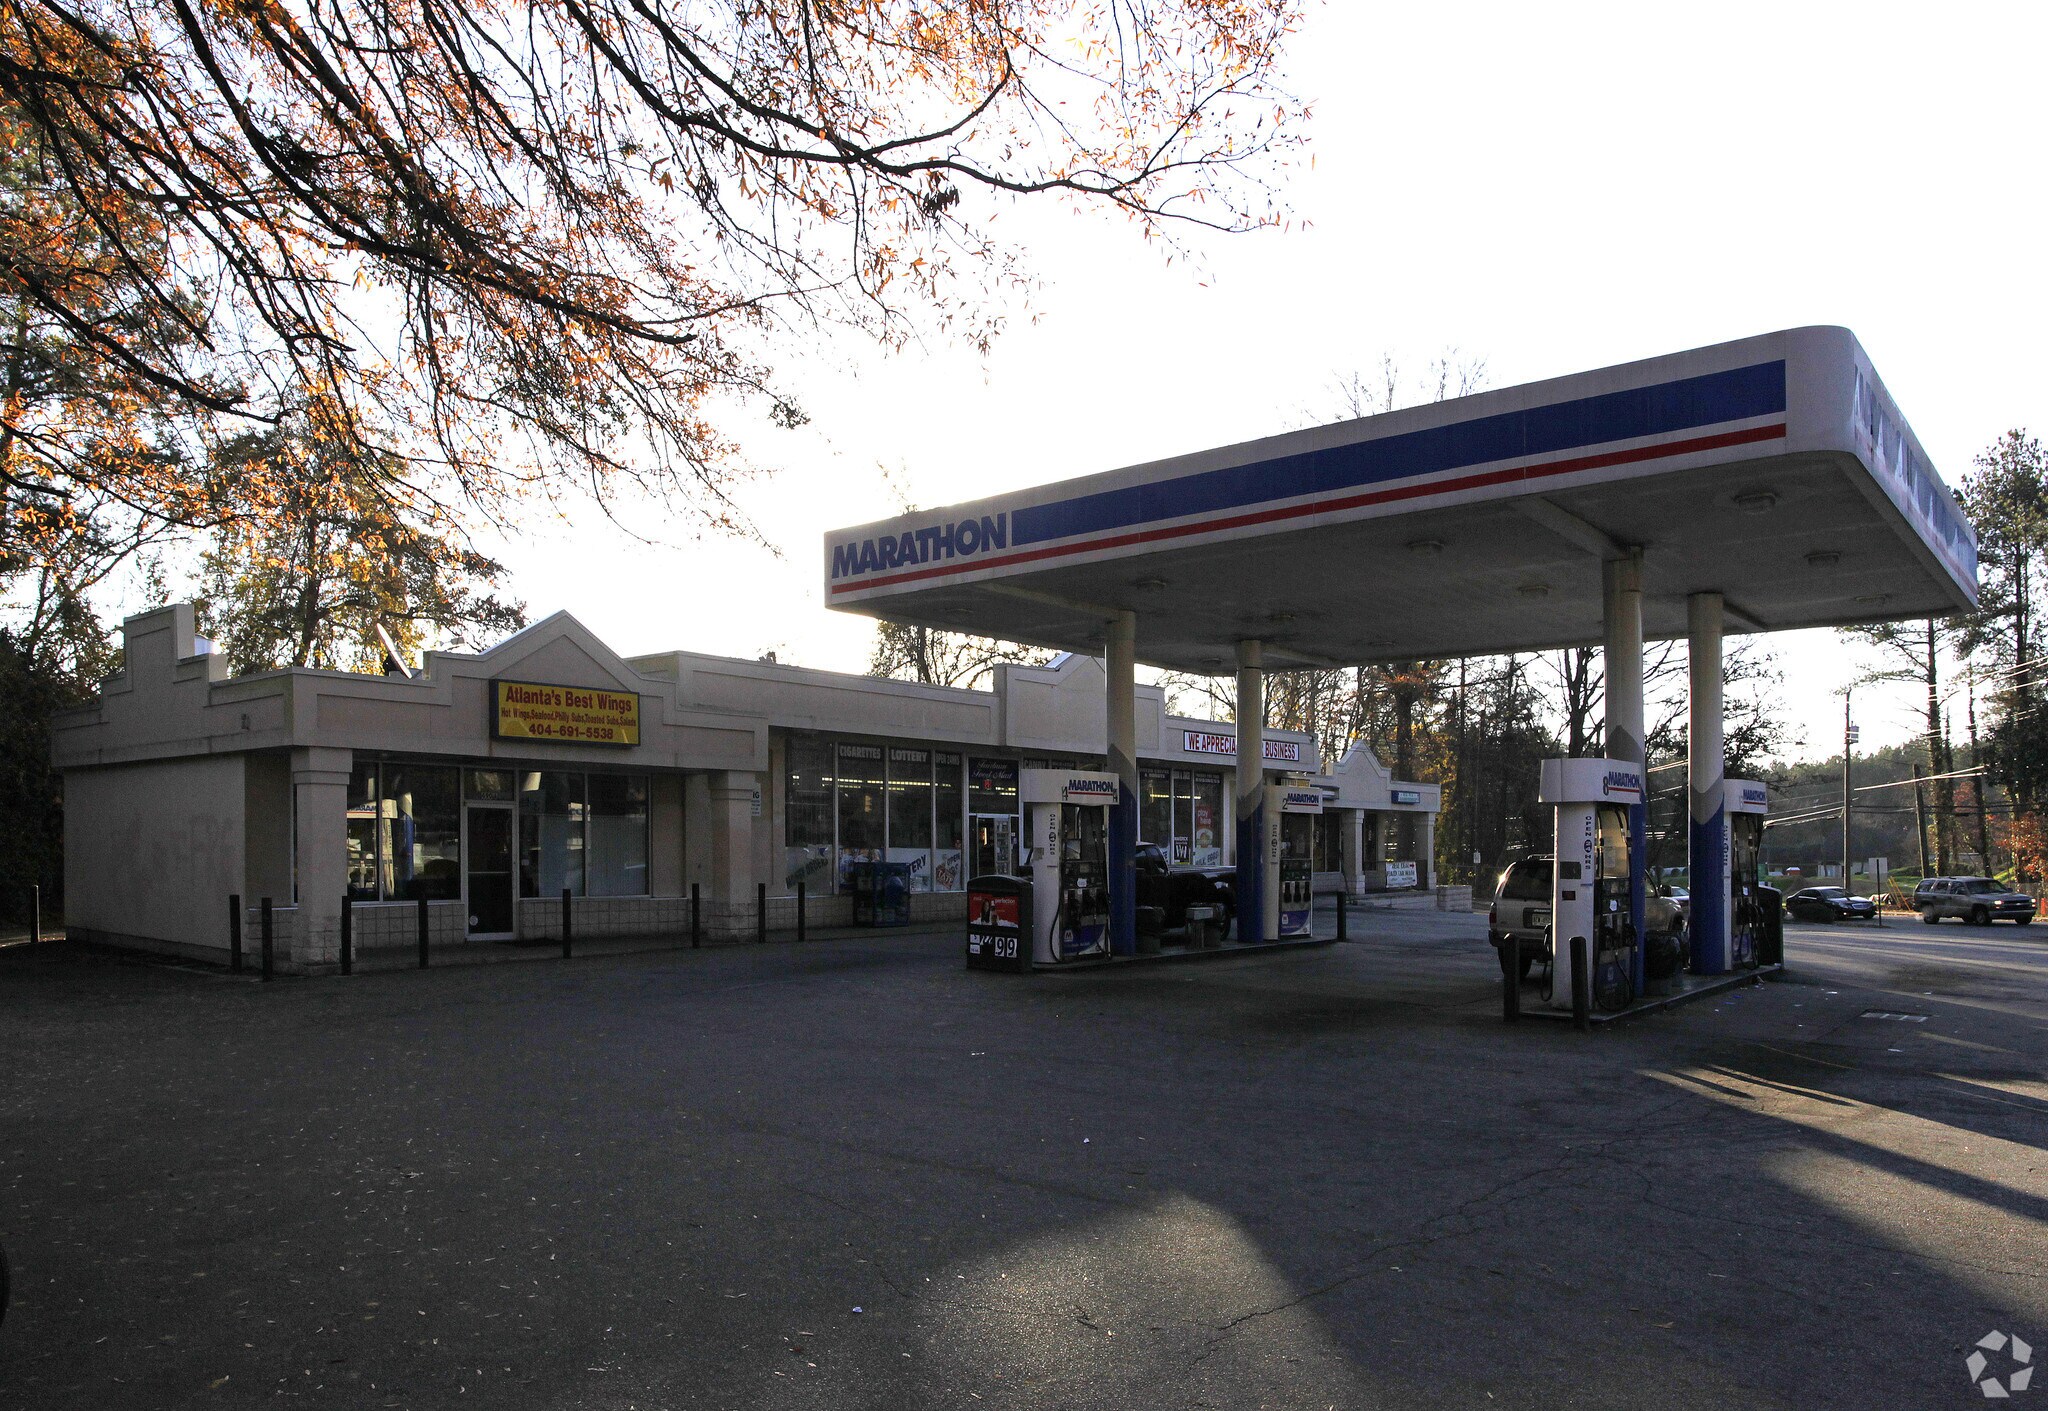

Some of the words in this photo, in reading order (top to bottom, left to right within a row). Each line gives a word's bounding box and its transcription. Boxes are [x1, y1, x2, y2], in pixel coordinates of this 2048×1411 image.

[832, 512, 1007, 579] MARATHON
[506, 686, 561, 707] Atlanta's
[565, 691, 593, 709] Best
[598, 694, 632, 715] Wings
[501, 708, 511, 718] Hot
[528, 723, 614, 740] 404-691-5538
[839, 745, 881, 760] CIGARETTES
[1189, 733, 1200, 750] WE
[1265, 742, 1296, 759] BUSINESS
[890, 749, 928, 762] LOTTERY
[1068, 780, 1113, 792] MARATHON
[1603, 776, 1609, 796] 8
[1608, 771, 1640, 788] MARATHON
[1282, 798, 1288, 810] 2
[1287, 793, 1319, 803] MARATHON
